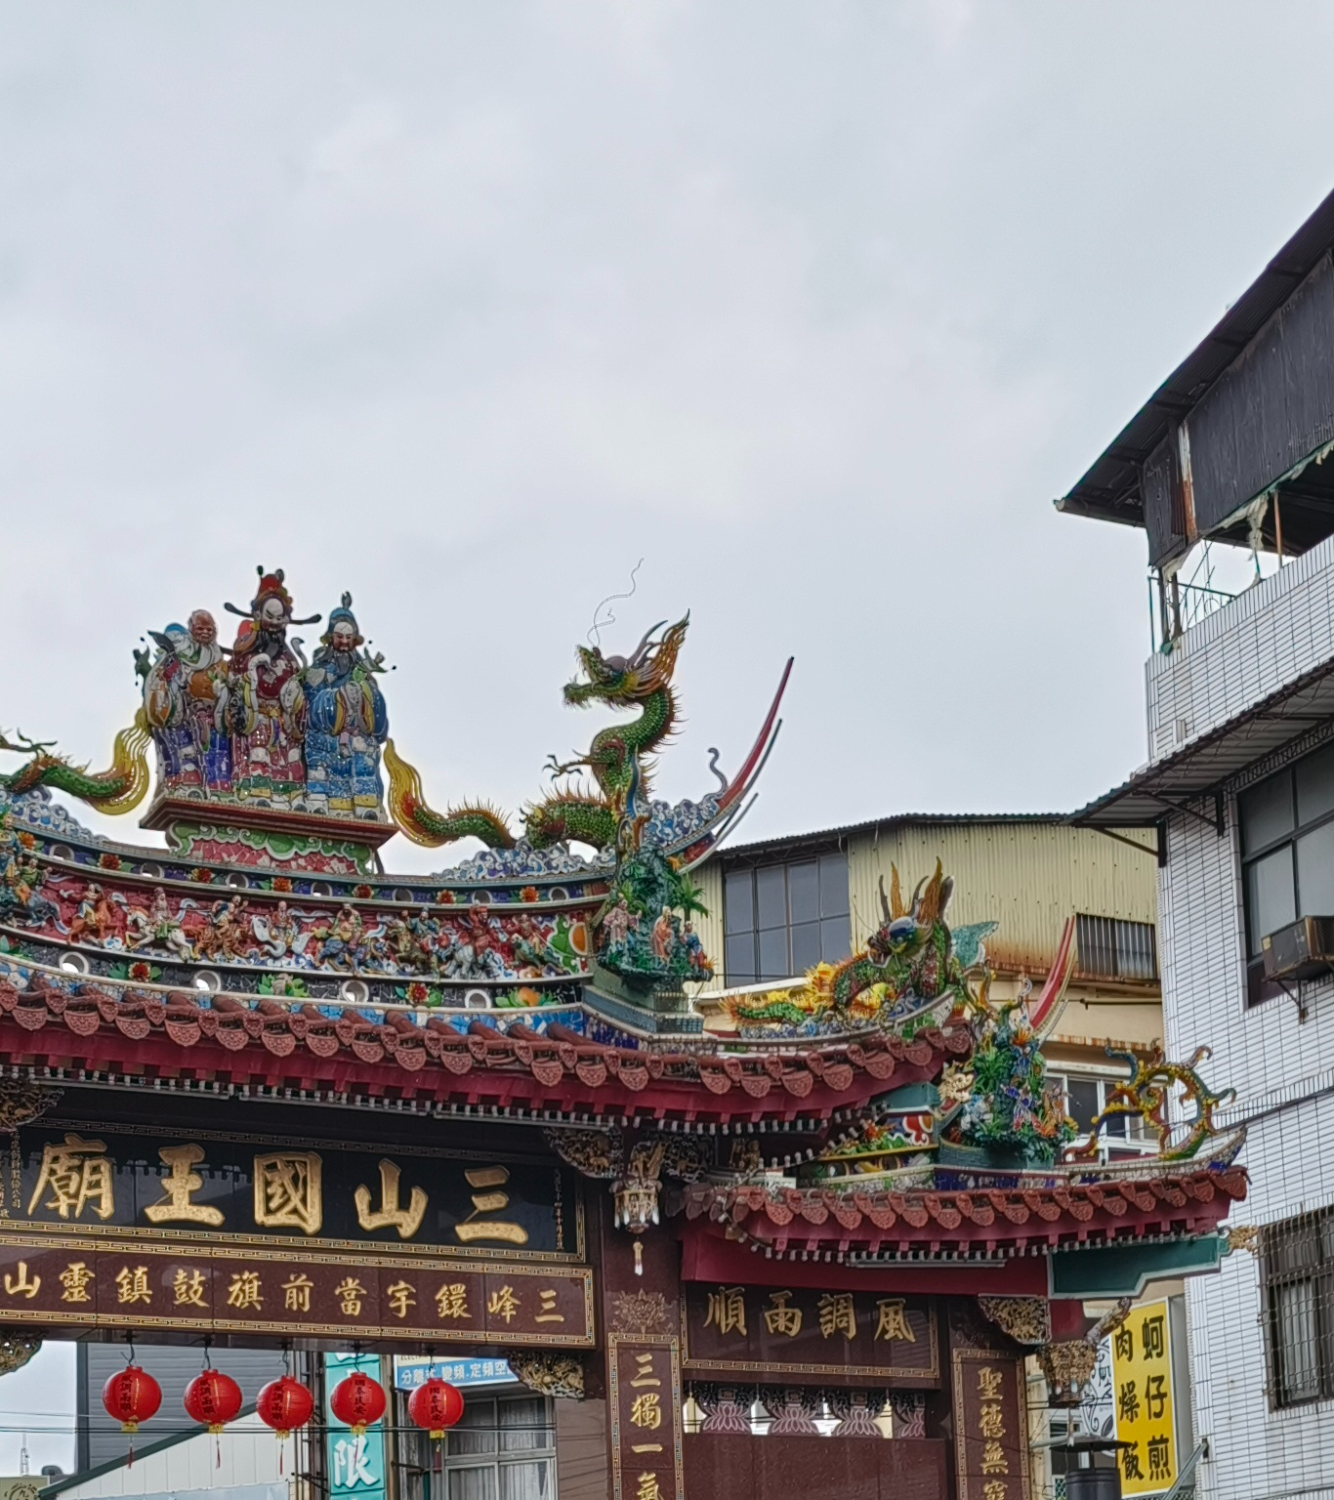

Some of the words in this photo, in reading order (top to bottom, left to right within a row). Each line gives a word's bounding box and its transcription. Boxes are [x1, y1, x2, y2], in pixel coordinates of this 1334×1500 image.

[27, 1134, 531, 1246] 三山國王廟
[703, 1286, 915, 1346] 風調雨順
[1141, 1314, 1173, 1482] 蚵仔煎
